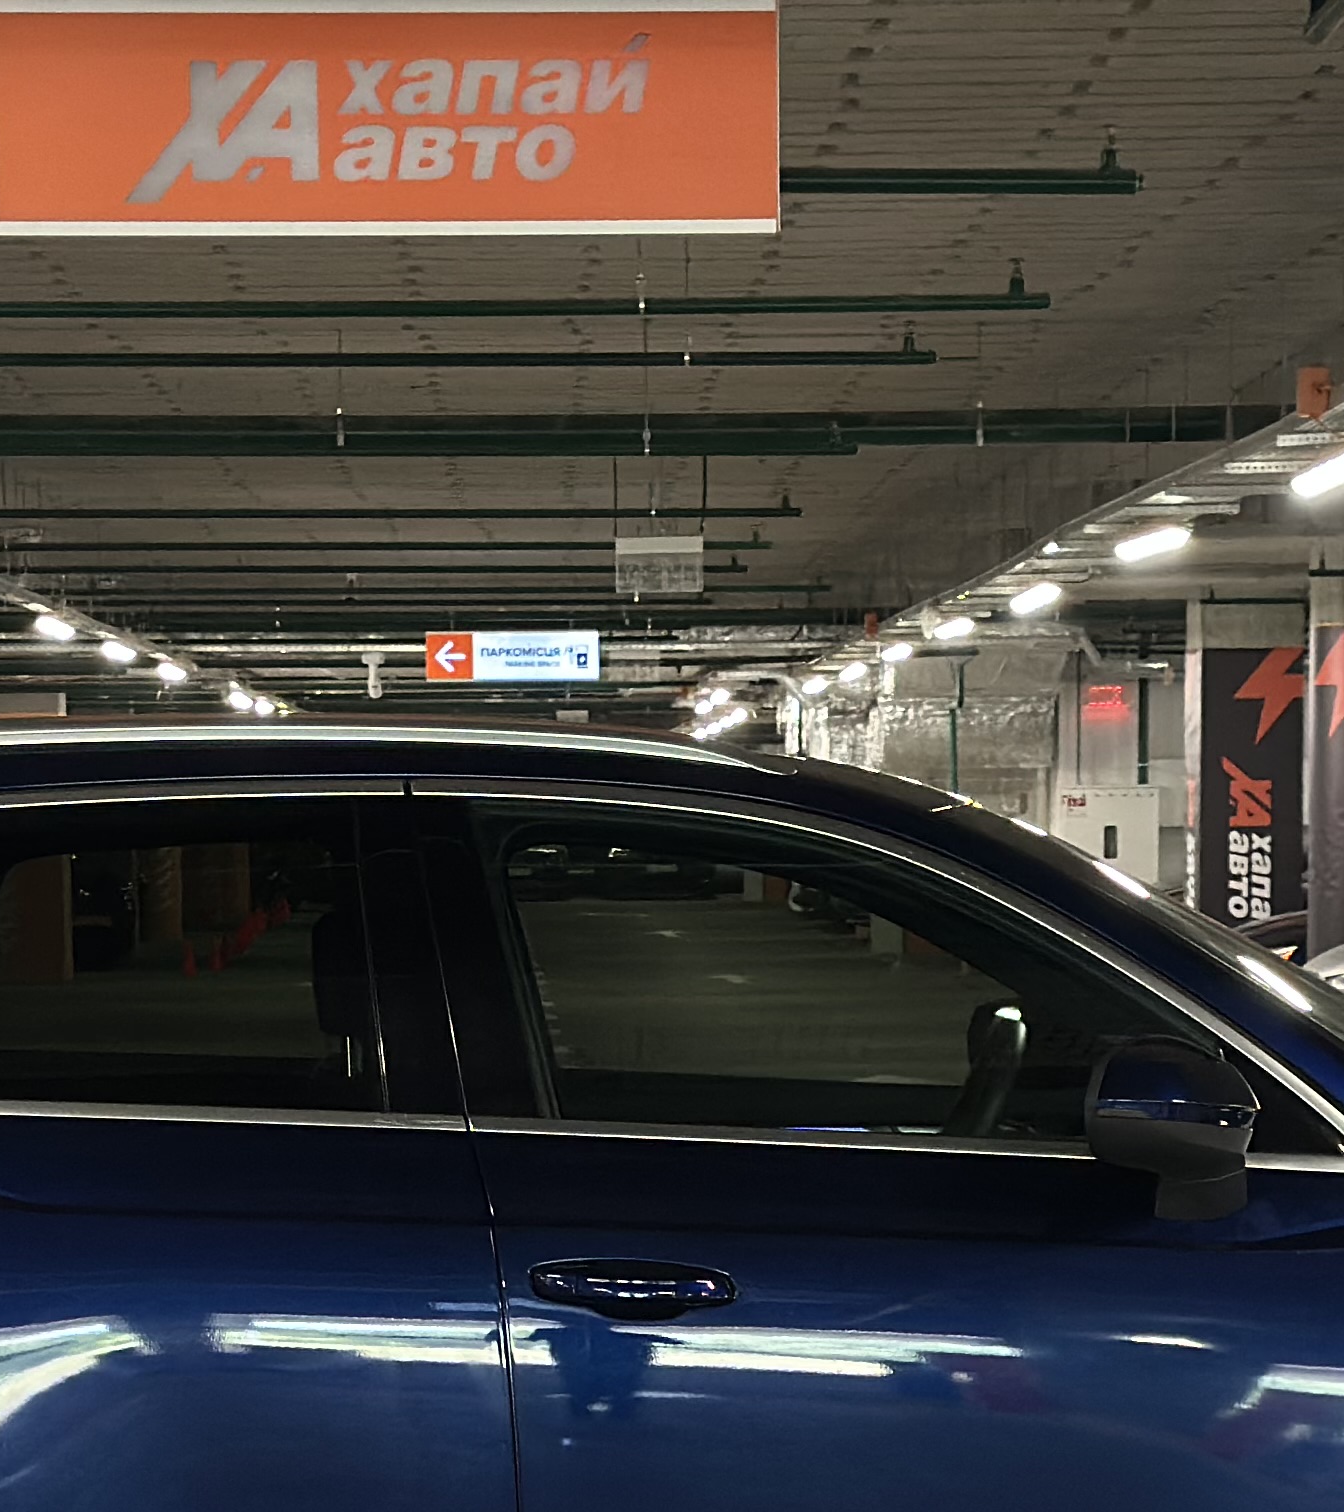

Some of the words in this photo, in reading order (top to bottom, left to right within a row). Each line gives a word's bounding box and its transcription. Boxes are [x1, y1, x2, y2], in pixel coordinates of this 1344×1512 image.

[338, 32, 651, 115] хапай
[333, 124, 576, 183] авто
[1227, 830, 1249, 919] авто
[1251, 833, 1273, 921] хапа
